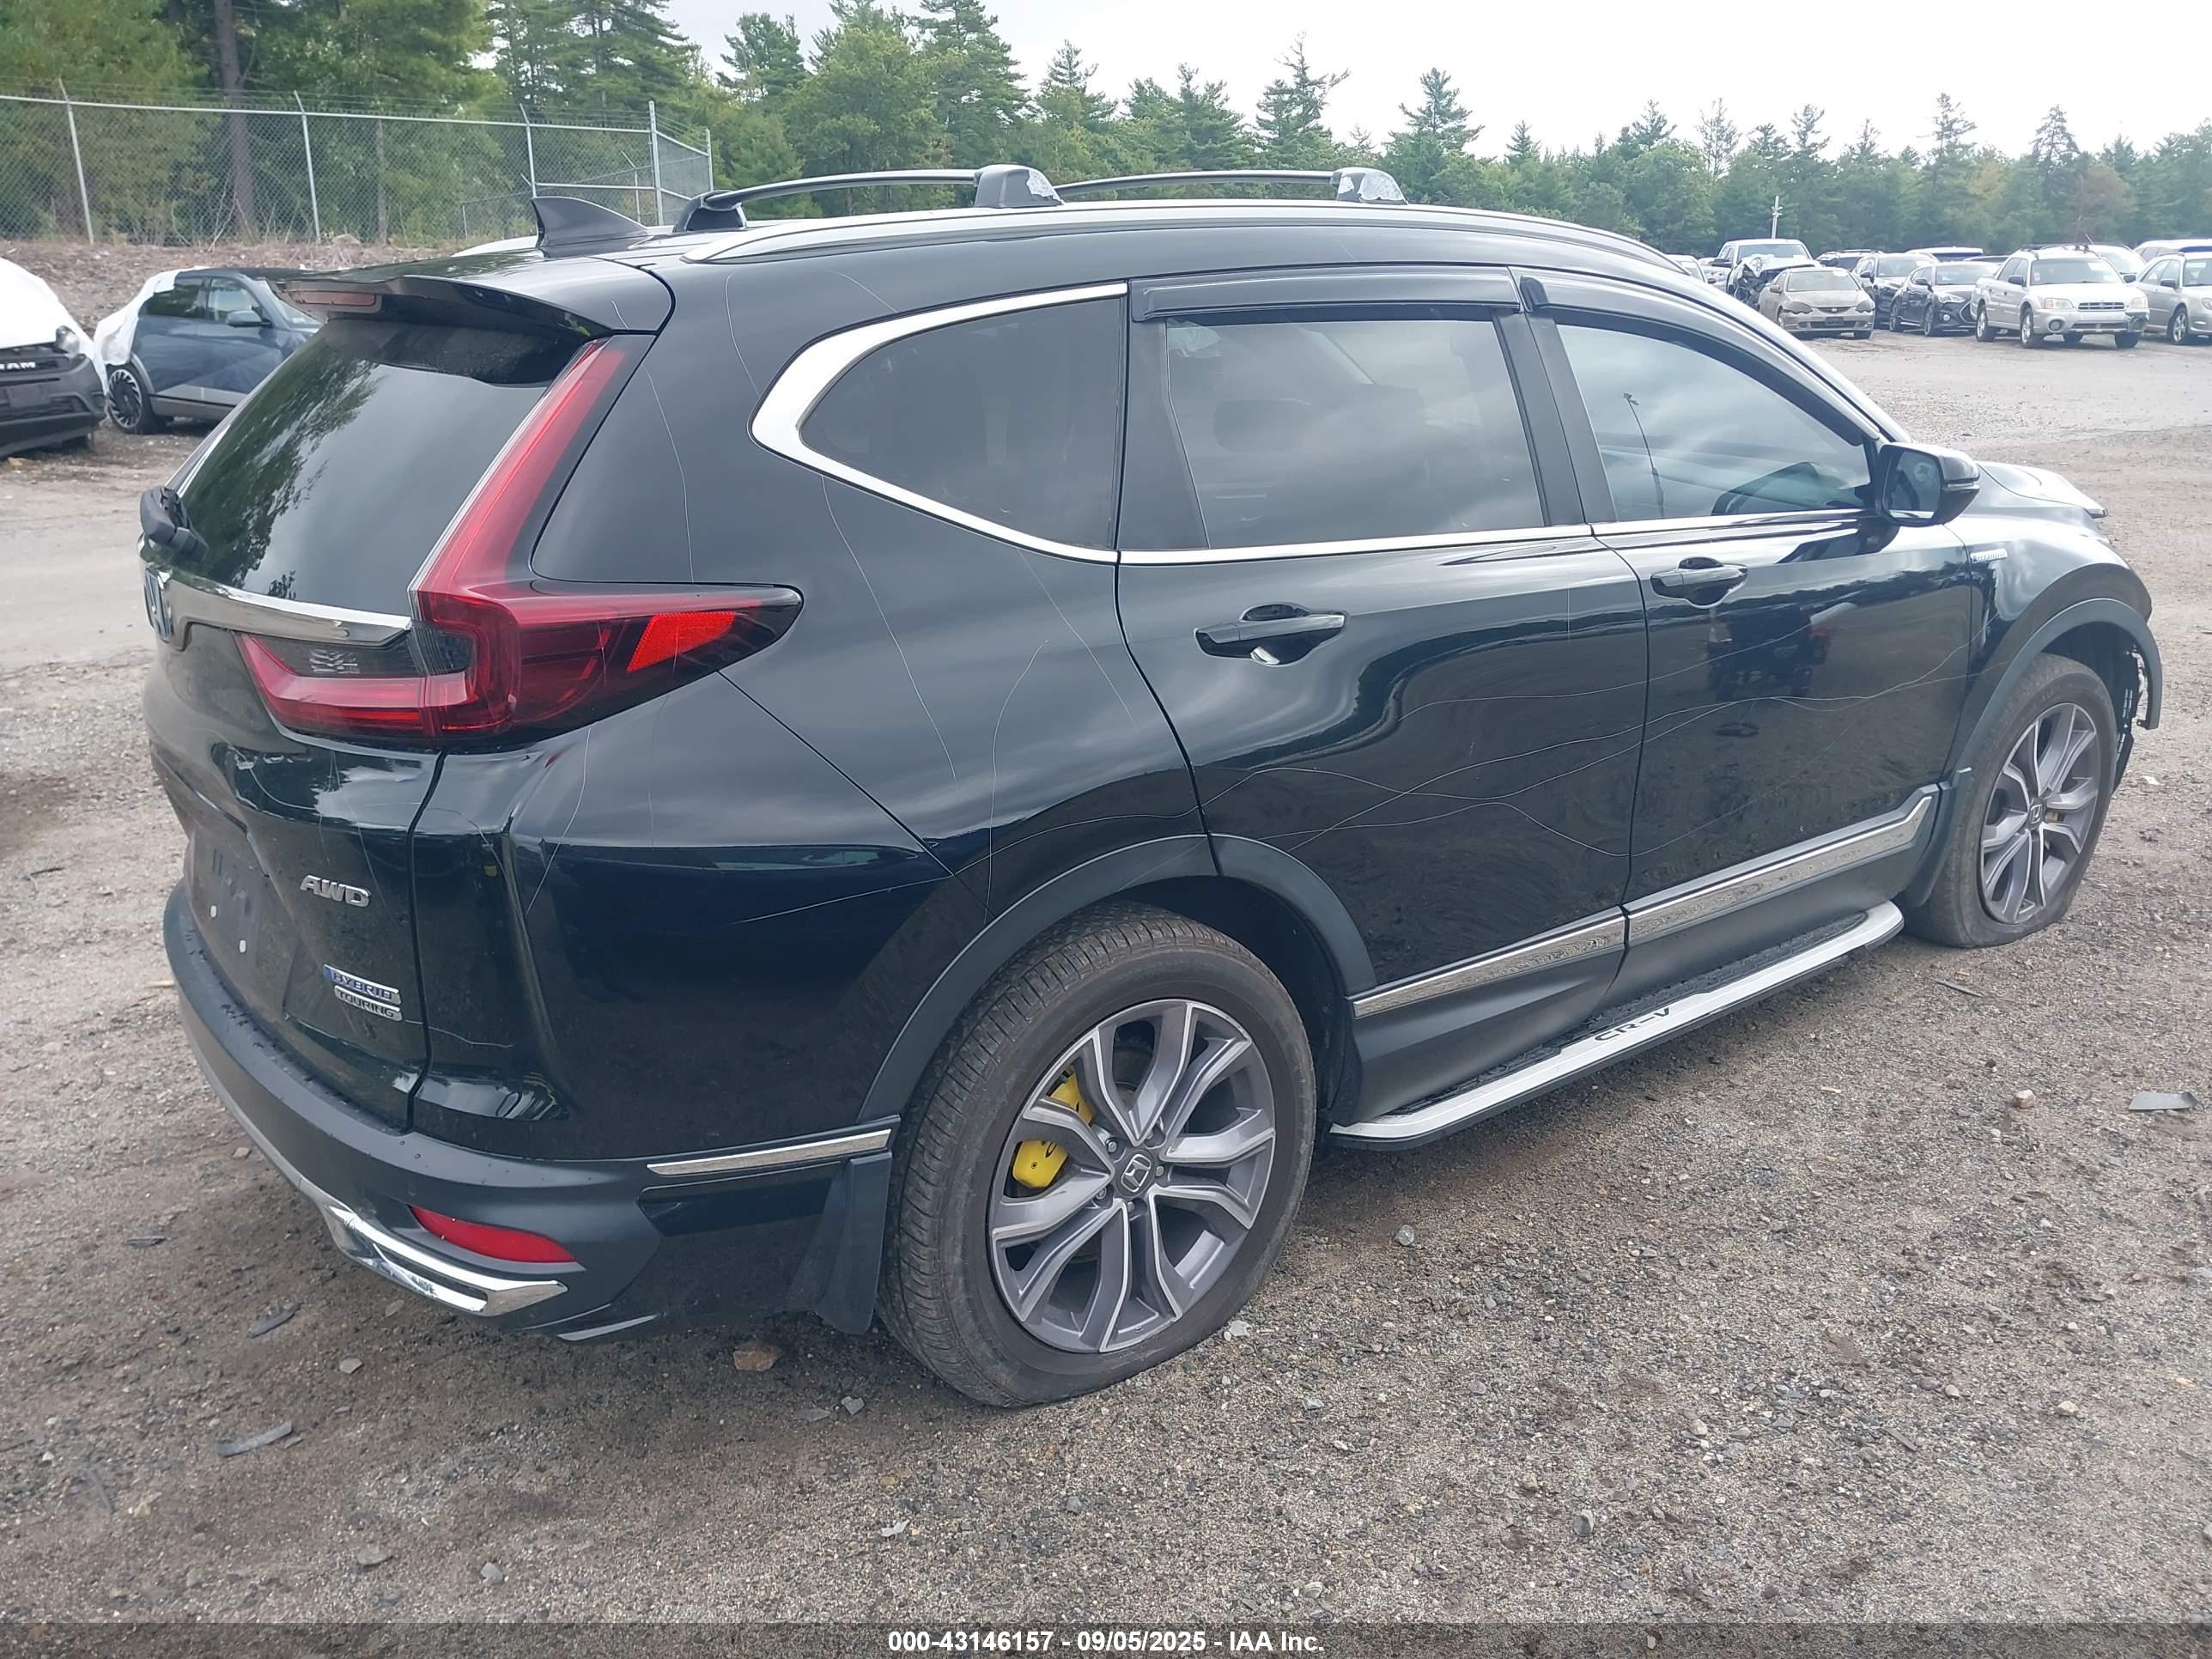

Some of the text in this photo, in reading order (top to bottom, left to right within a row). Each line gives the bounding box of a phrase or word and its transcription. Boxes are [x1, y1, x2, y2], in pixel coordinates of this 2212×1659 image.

[301, 874, 371, 908] AWD
[330, 969, 392, 1001] HYBRID
[337, 989, 395, 1018] TOURING
[1595, 1006, 1670, 1042] CR-V
